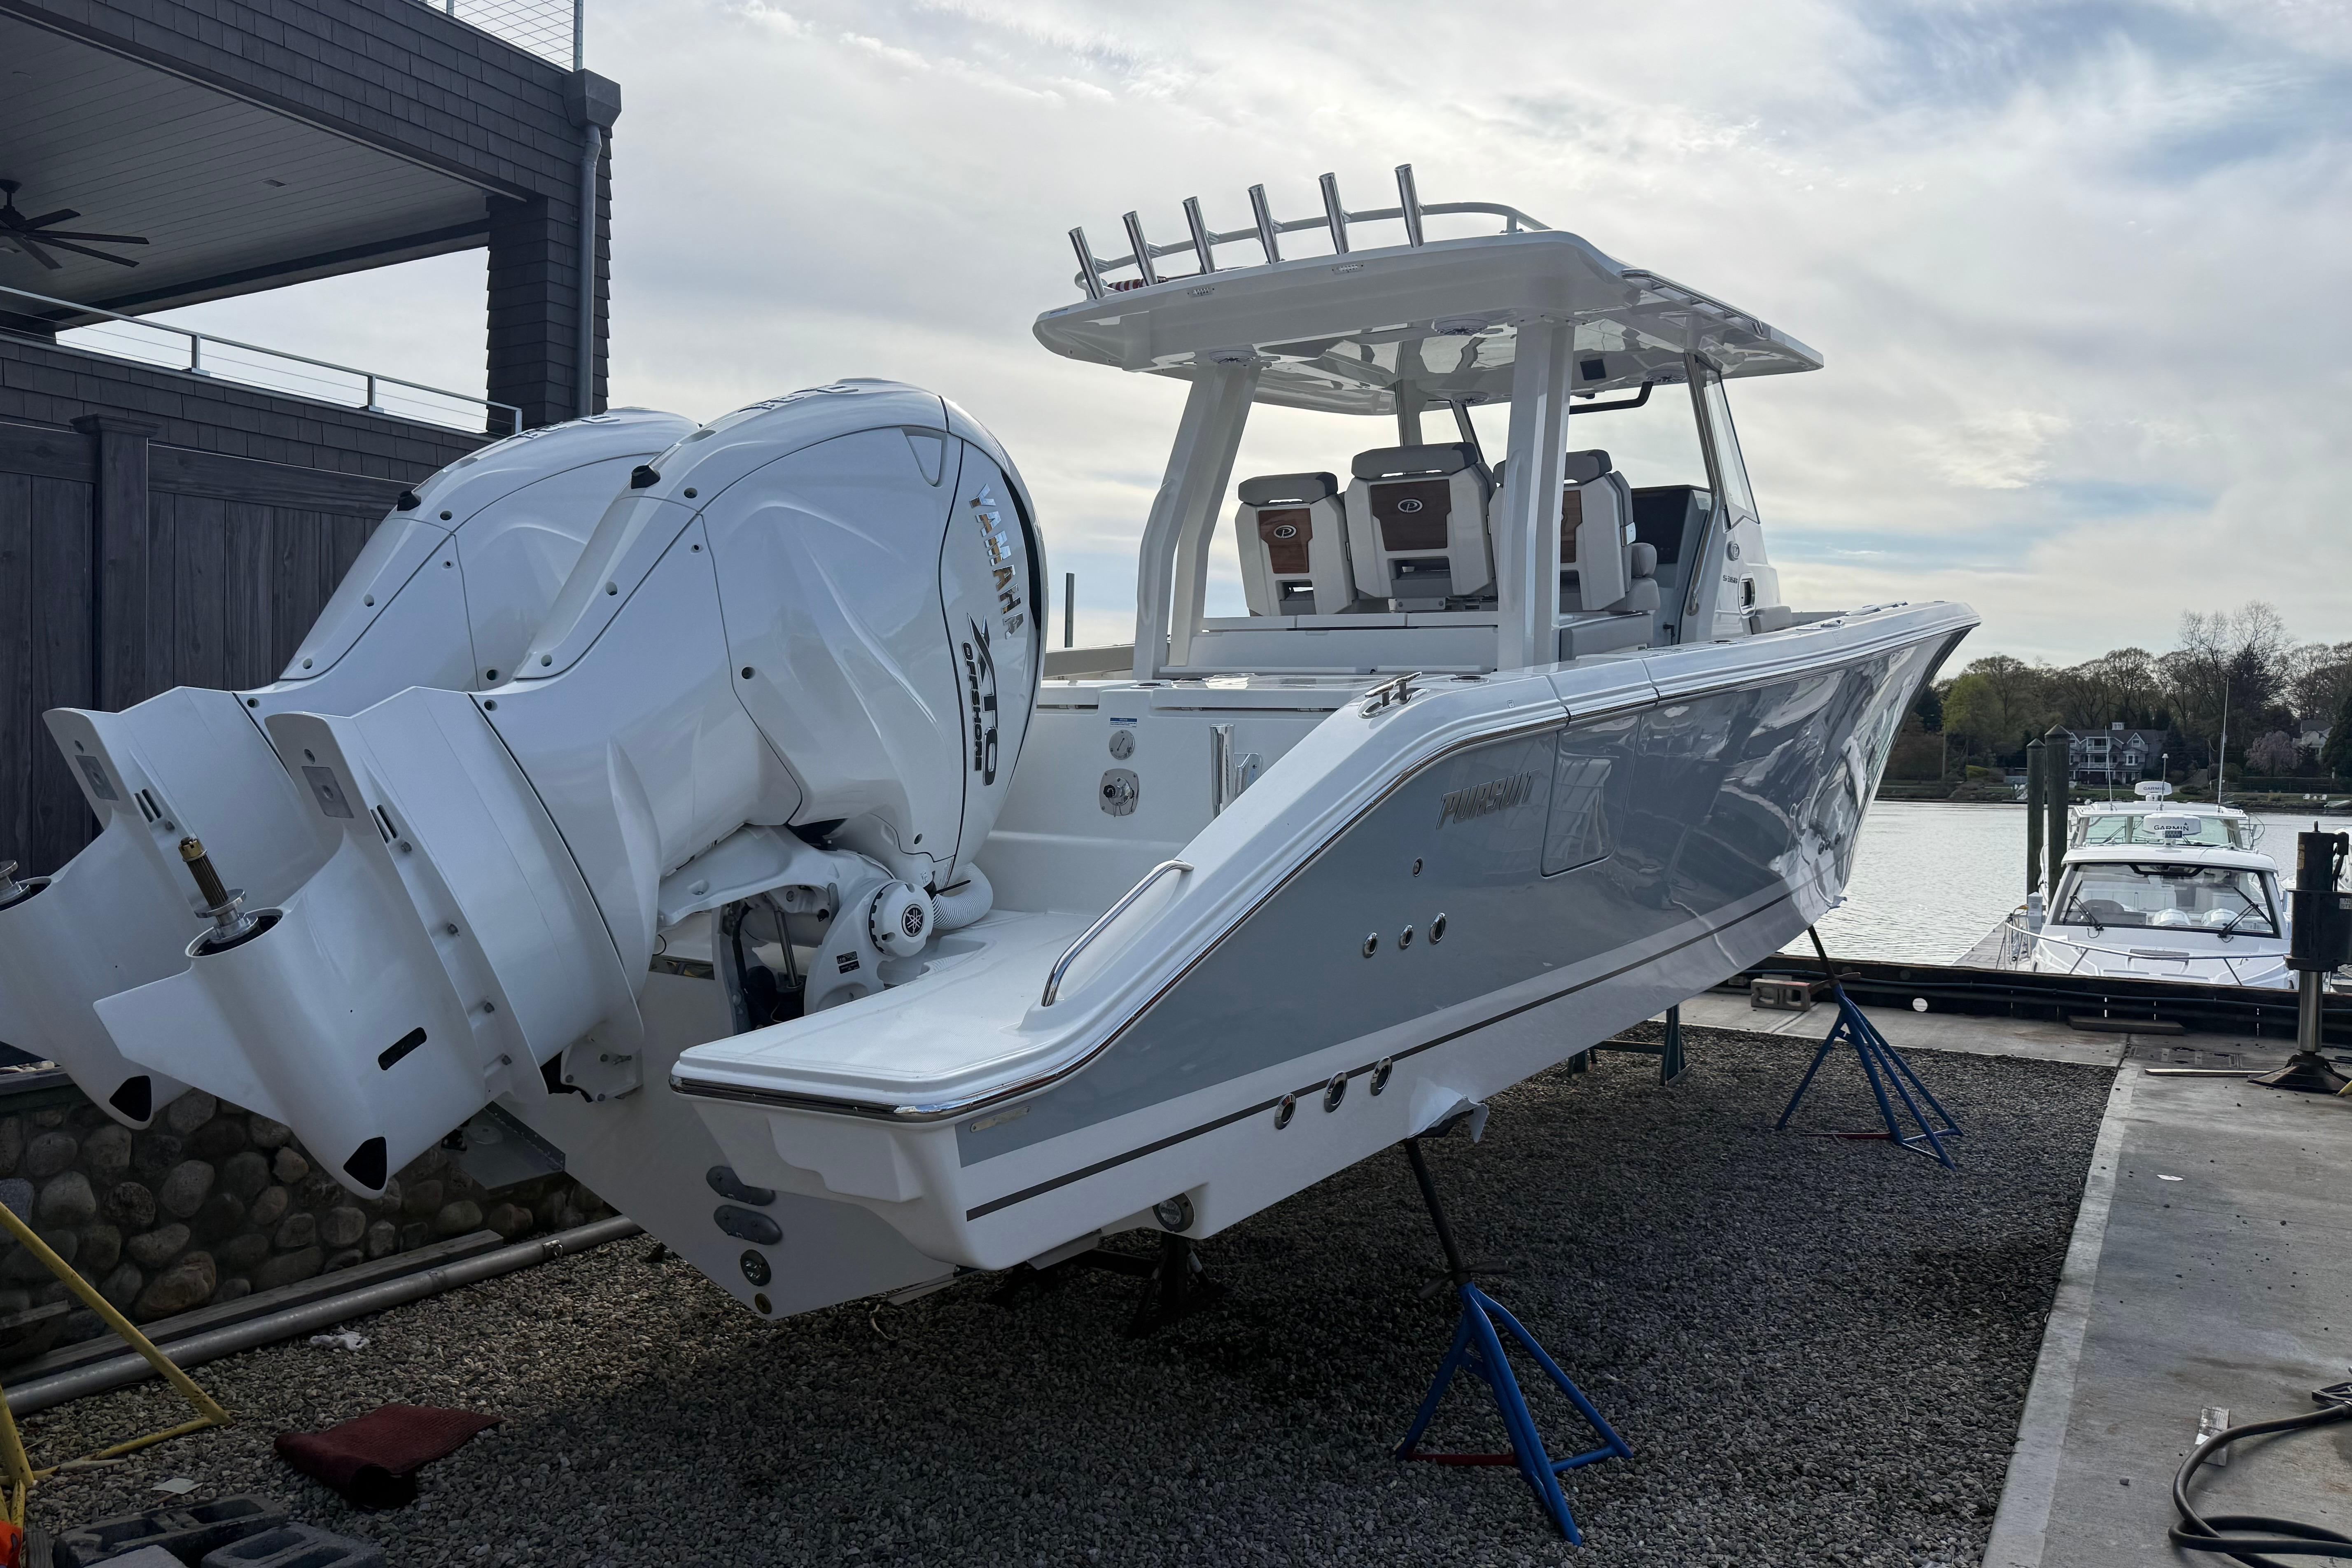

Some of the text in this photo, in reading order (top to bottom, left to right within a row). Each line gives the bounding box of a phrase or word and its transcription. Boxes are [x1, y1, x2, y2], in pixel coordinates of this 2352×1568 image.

[969, 483, 1025, 639] YAMAHA
[961, 641, 982, 772] OFFSHORE
[966, 612, 999, 786] XTO
[1436, 768, 1541, 830] PURSUIT
